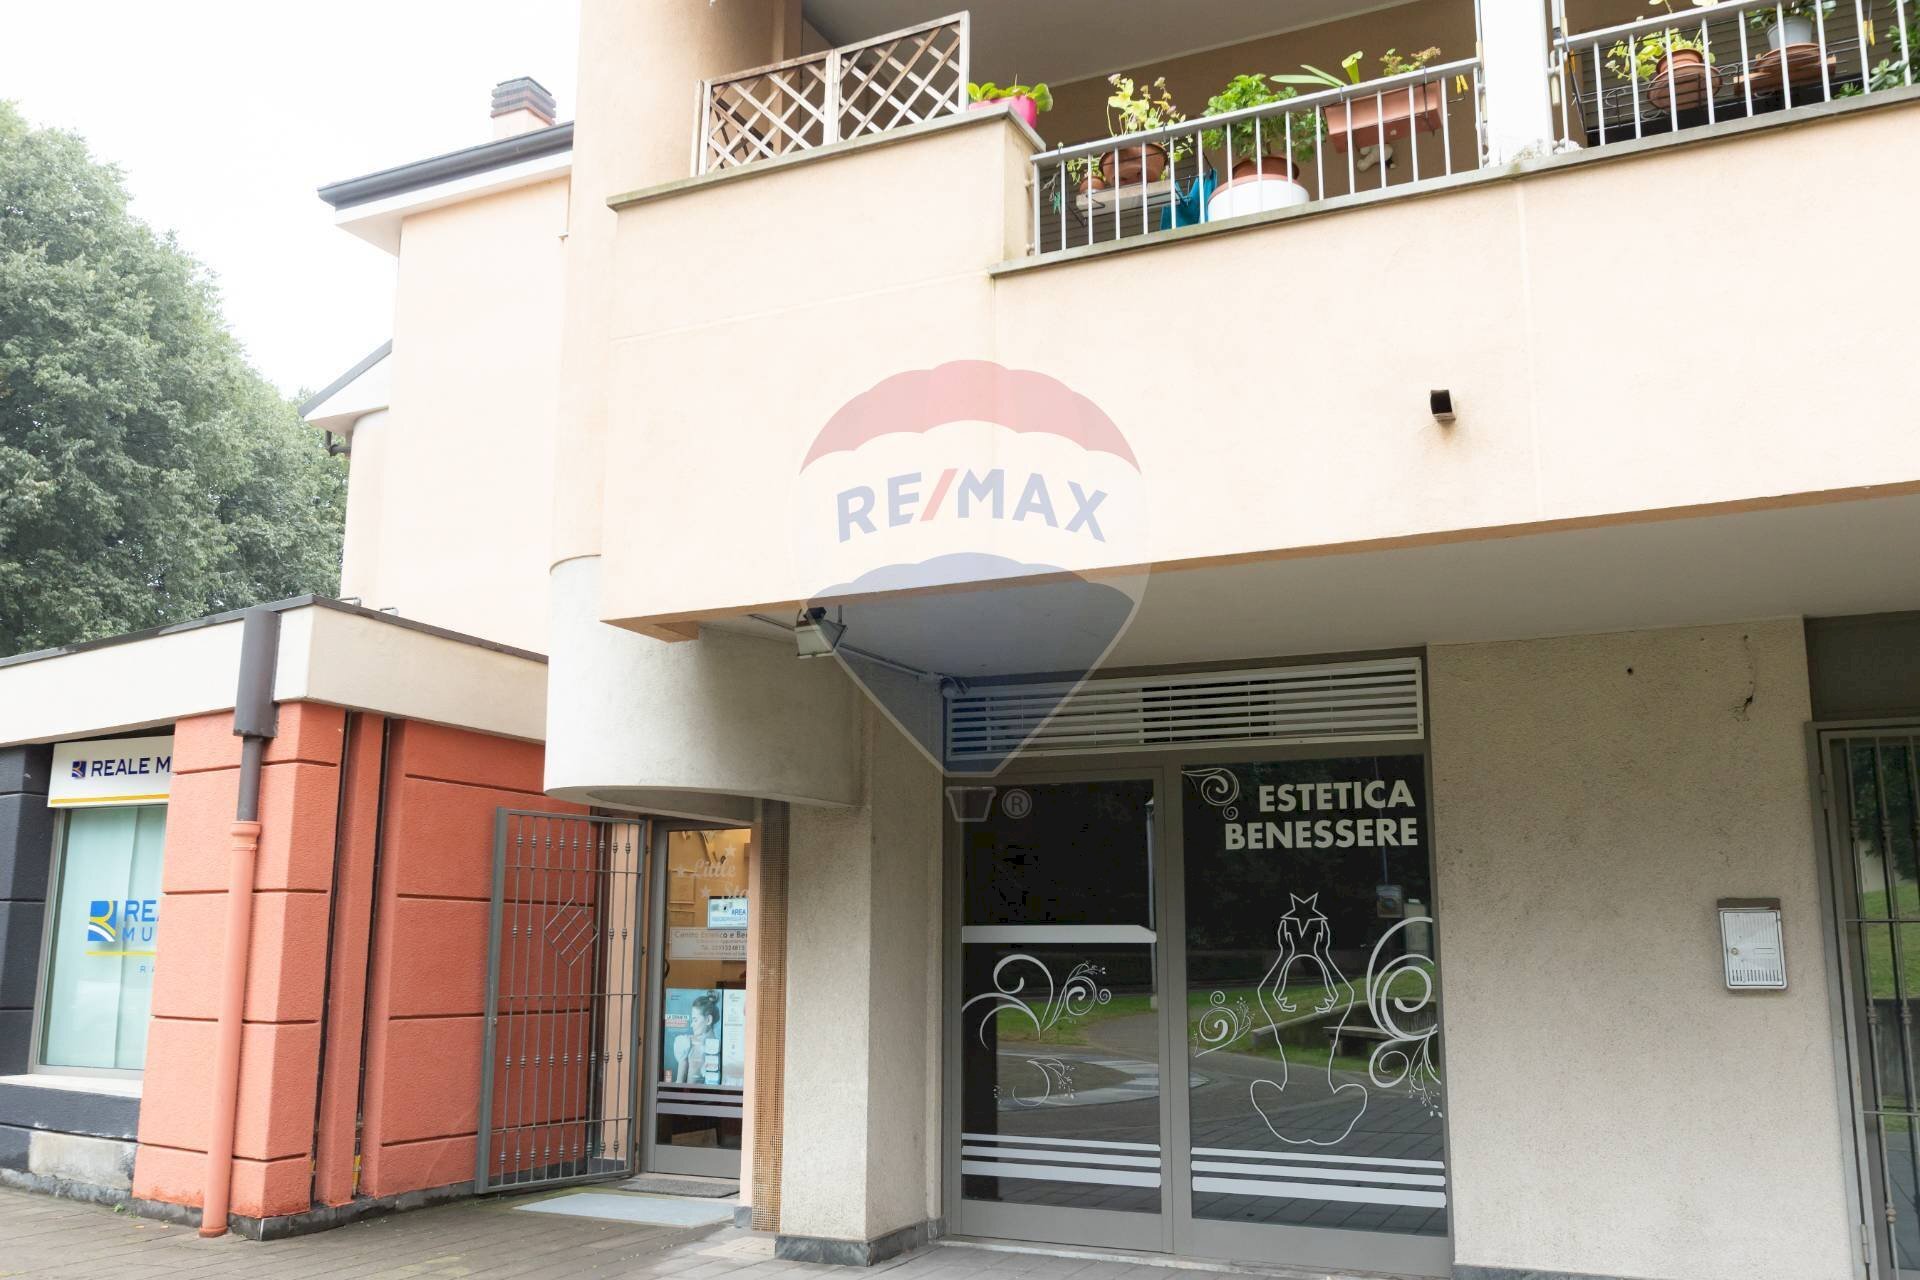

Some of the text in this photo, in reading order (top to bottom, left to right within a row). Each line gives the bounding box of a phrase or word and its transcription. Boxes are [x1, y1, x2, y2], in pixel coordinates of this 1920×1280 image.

[91, 758, 151, 777] REALE
[1259, 779, 1416, 813] ESTETICA
[1225, 817, 1418, 850] BENESSERE
[124, 899, 159, 922] RE
